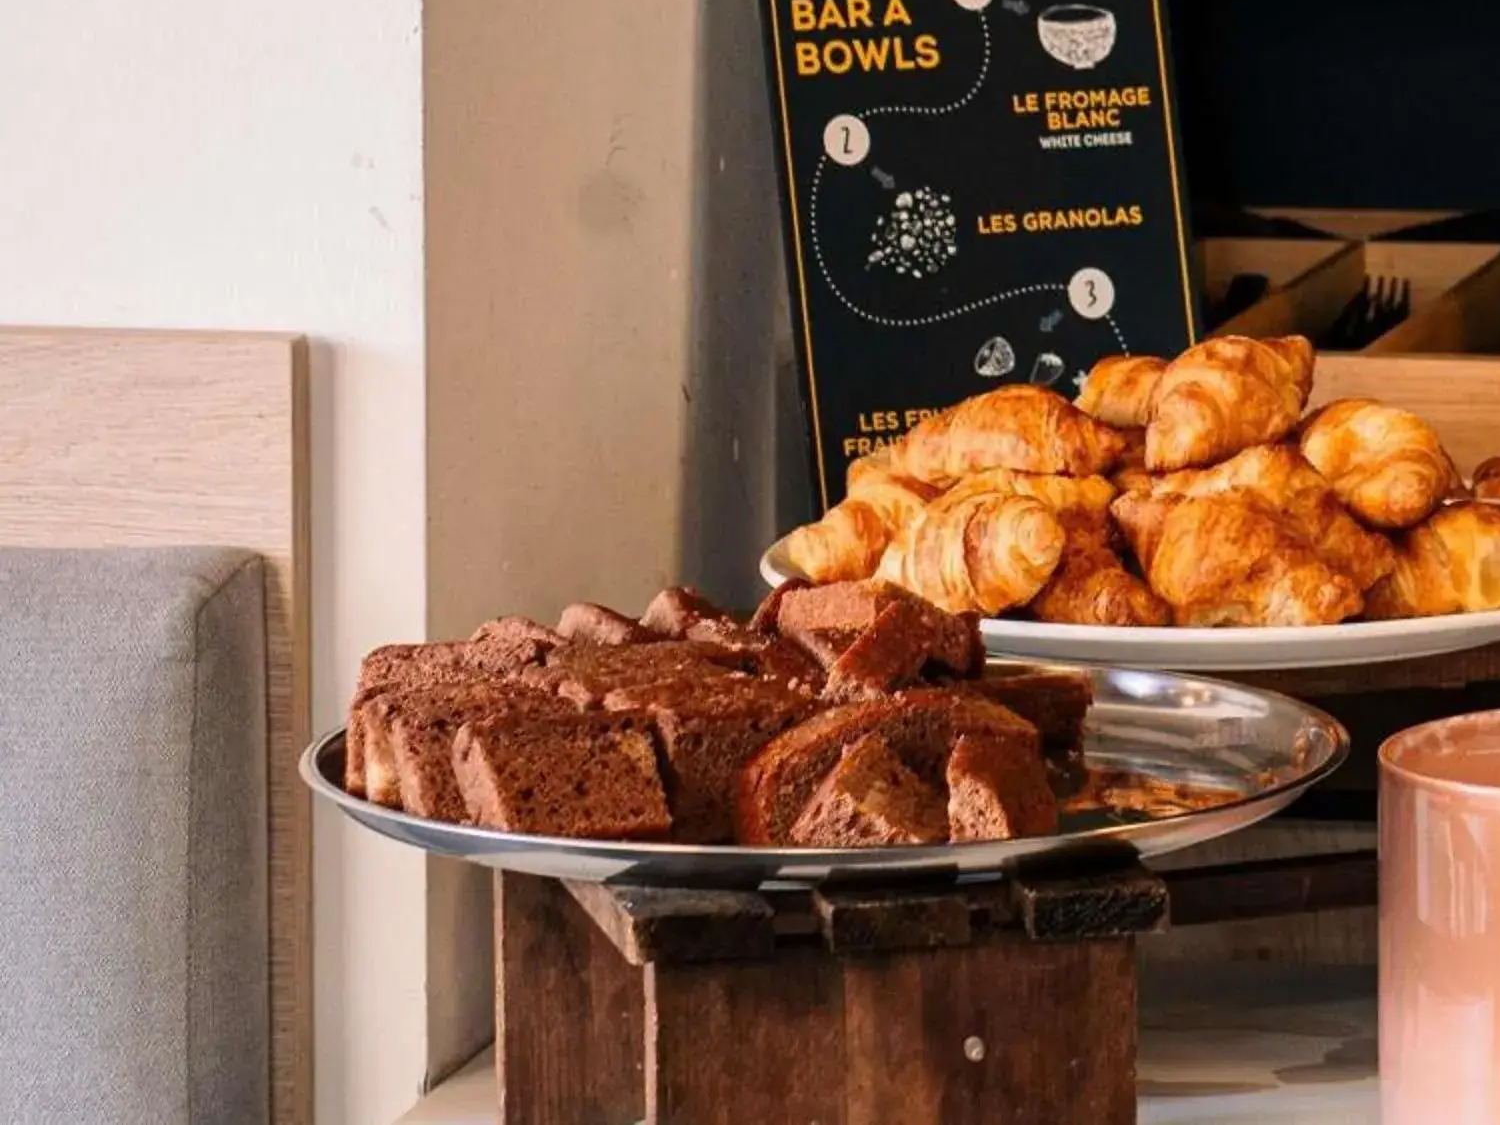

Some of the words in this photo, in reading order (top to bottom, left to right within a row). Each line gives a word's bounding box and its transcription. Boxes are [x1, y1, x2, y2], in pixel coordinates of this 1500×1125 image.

[796, 34, 941, 76] BOWLS
[1012, 92, 1040, 113] LE
[1045, 86, 1151, 110] FROMAGE
[1048, 108, 1121, 130] BLANC
[1039, 133, 1081, 150] WHITE
[1083, 131, 1133, 148] CHEESE
[977, 213, 1017, 234] LES
[1022, 204, 1143, 232] GRANOLAS
[859, 410, 899, 432] LES
